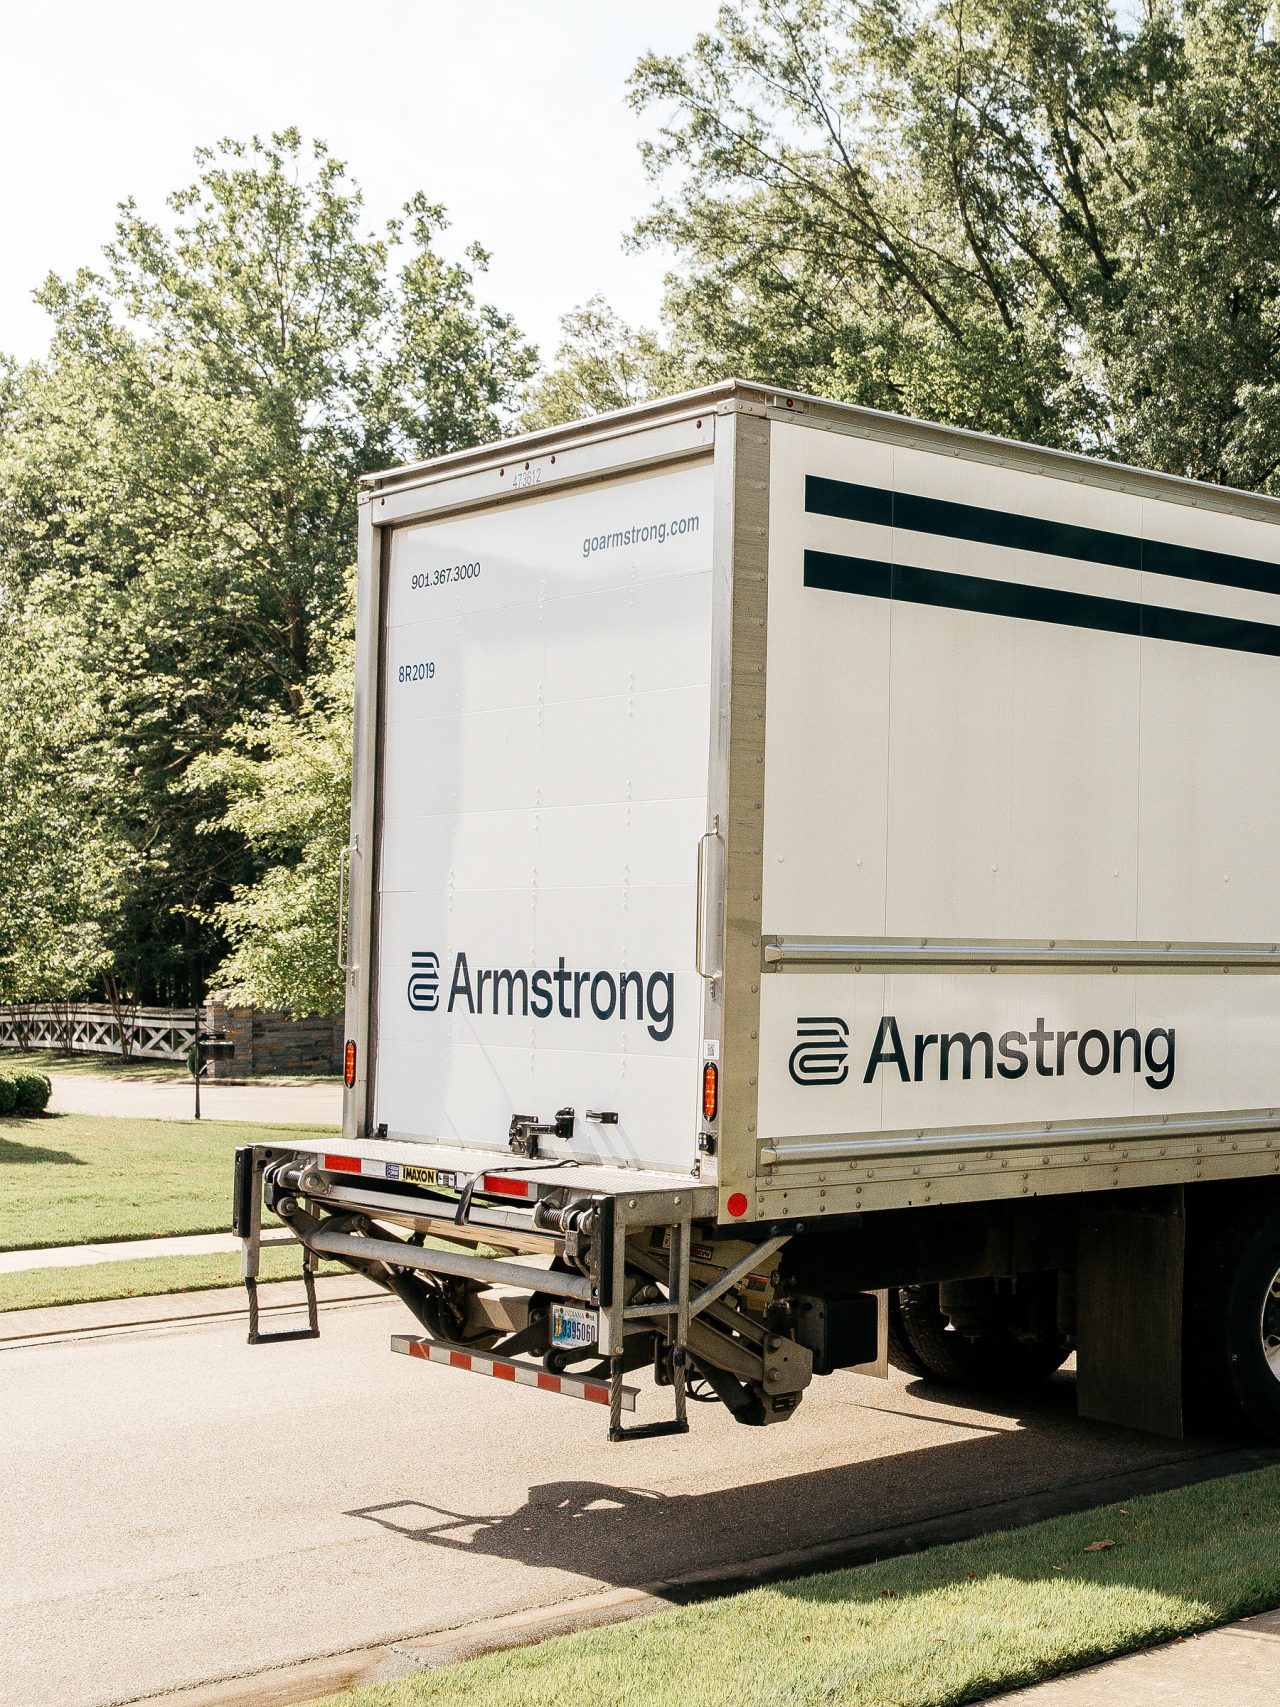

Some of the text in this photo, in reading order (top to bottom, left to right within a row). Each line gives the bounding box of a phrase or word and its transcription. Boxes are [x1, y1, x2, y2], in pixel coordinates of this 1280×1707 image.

[582, 515, 700, 558] goarmstrong.com
[411, 562, 481, 589] 901.367.3000
[398, 661, 435, 682] 8R2019
[447, 951, 675, 1042] Armstrong
[862, 1015, 1176, 1090] Armstrong
[405, 1167, 435, 1184] MAXON
